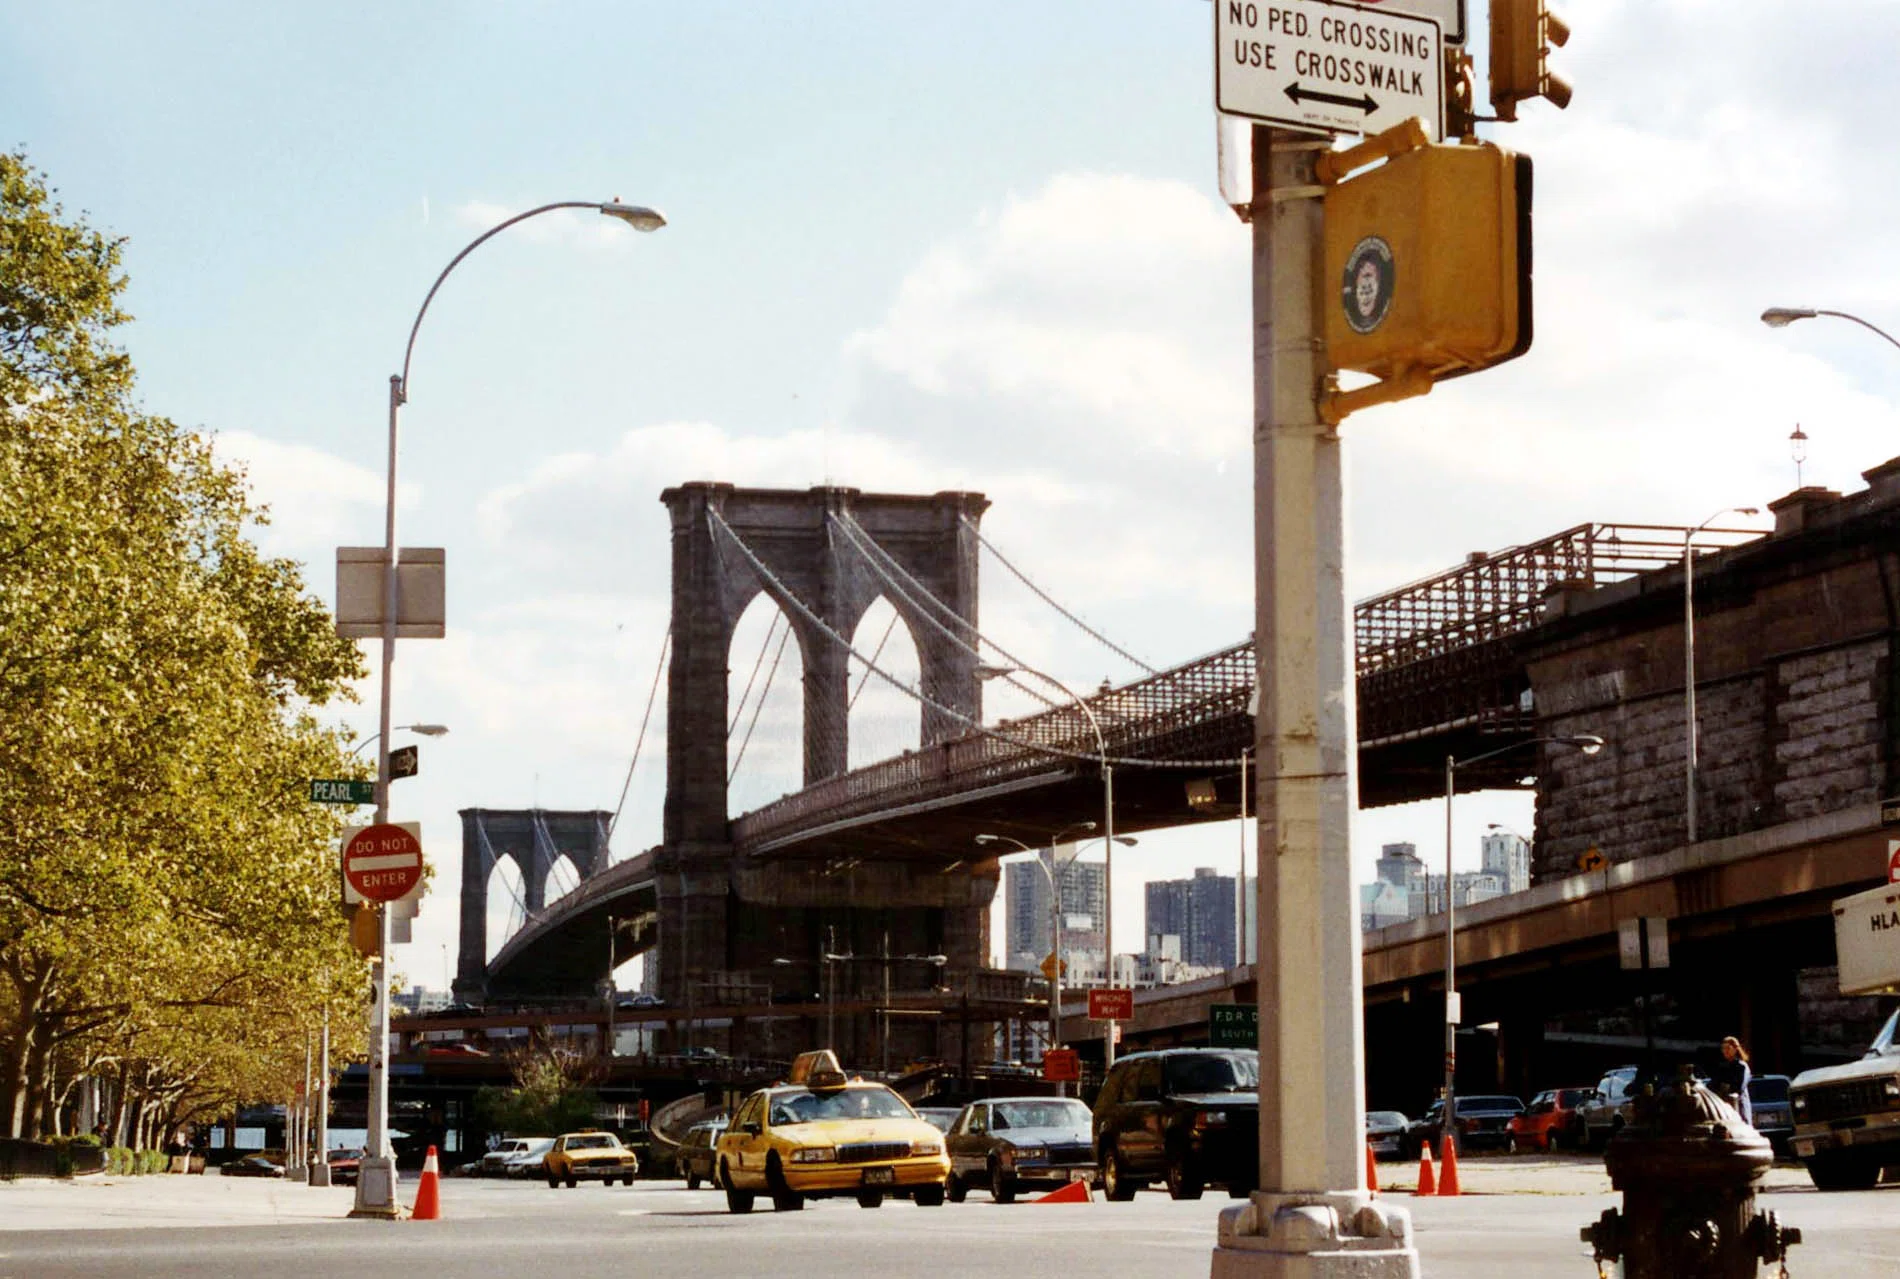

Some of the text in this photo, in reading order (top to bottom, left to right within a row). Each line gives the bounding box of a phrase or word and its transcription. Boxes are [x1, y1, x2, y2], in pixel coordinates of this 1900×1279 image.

[1229, 0, 1429, 60] NO PED. CROSSING
[1235, 38, 1423, 97] USE CROSSWALK
[313, 782, 372, 801] PEARL ST
[355, 838, 409, 854] DO NOT
[362, 872, 407, 888] ENTER
[1101, 1006, 1121, 1015] WAY
